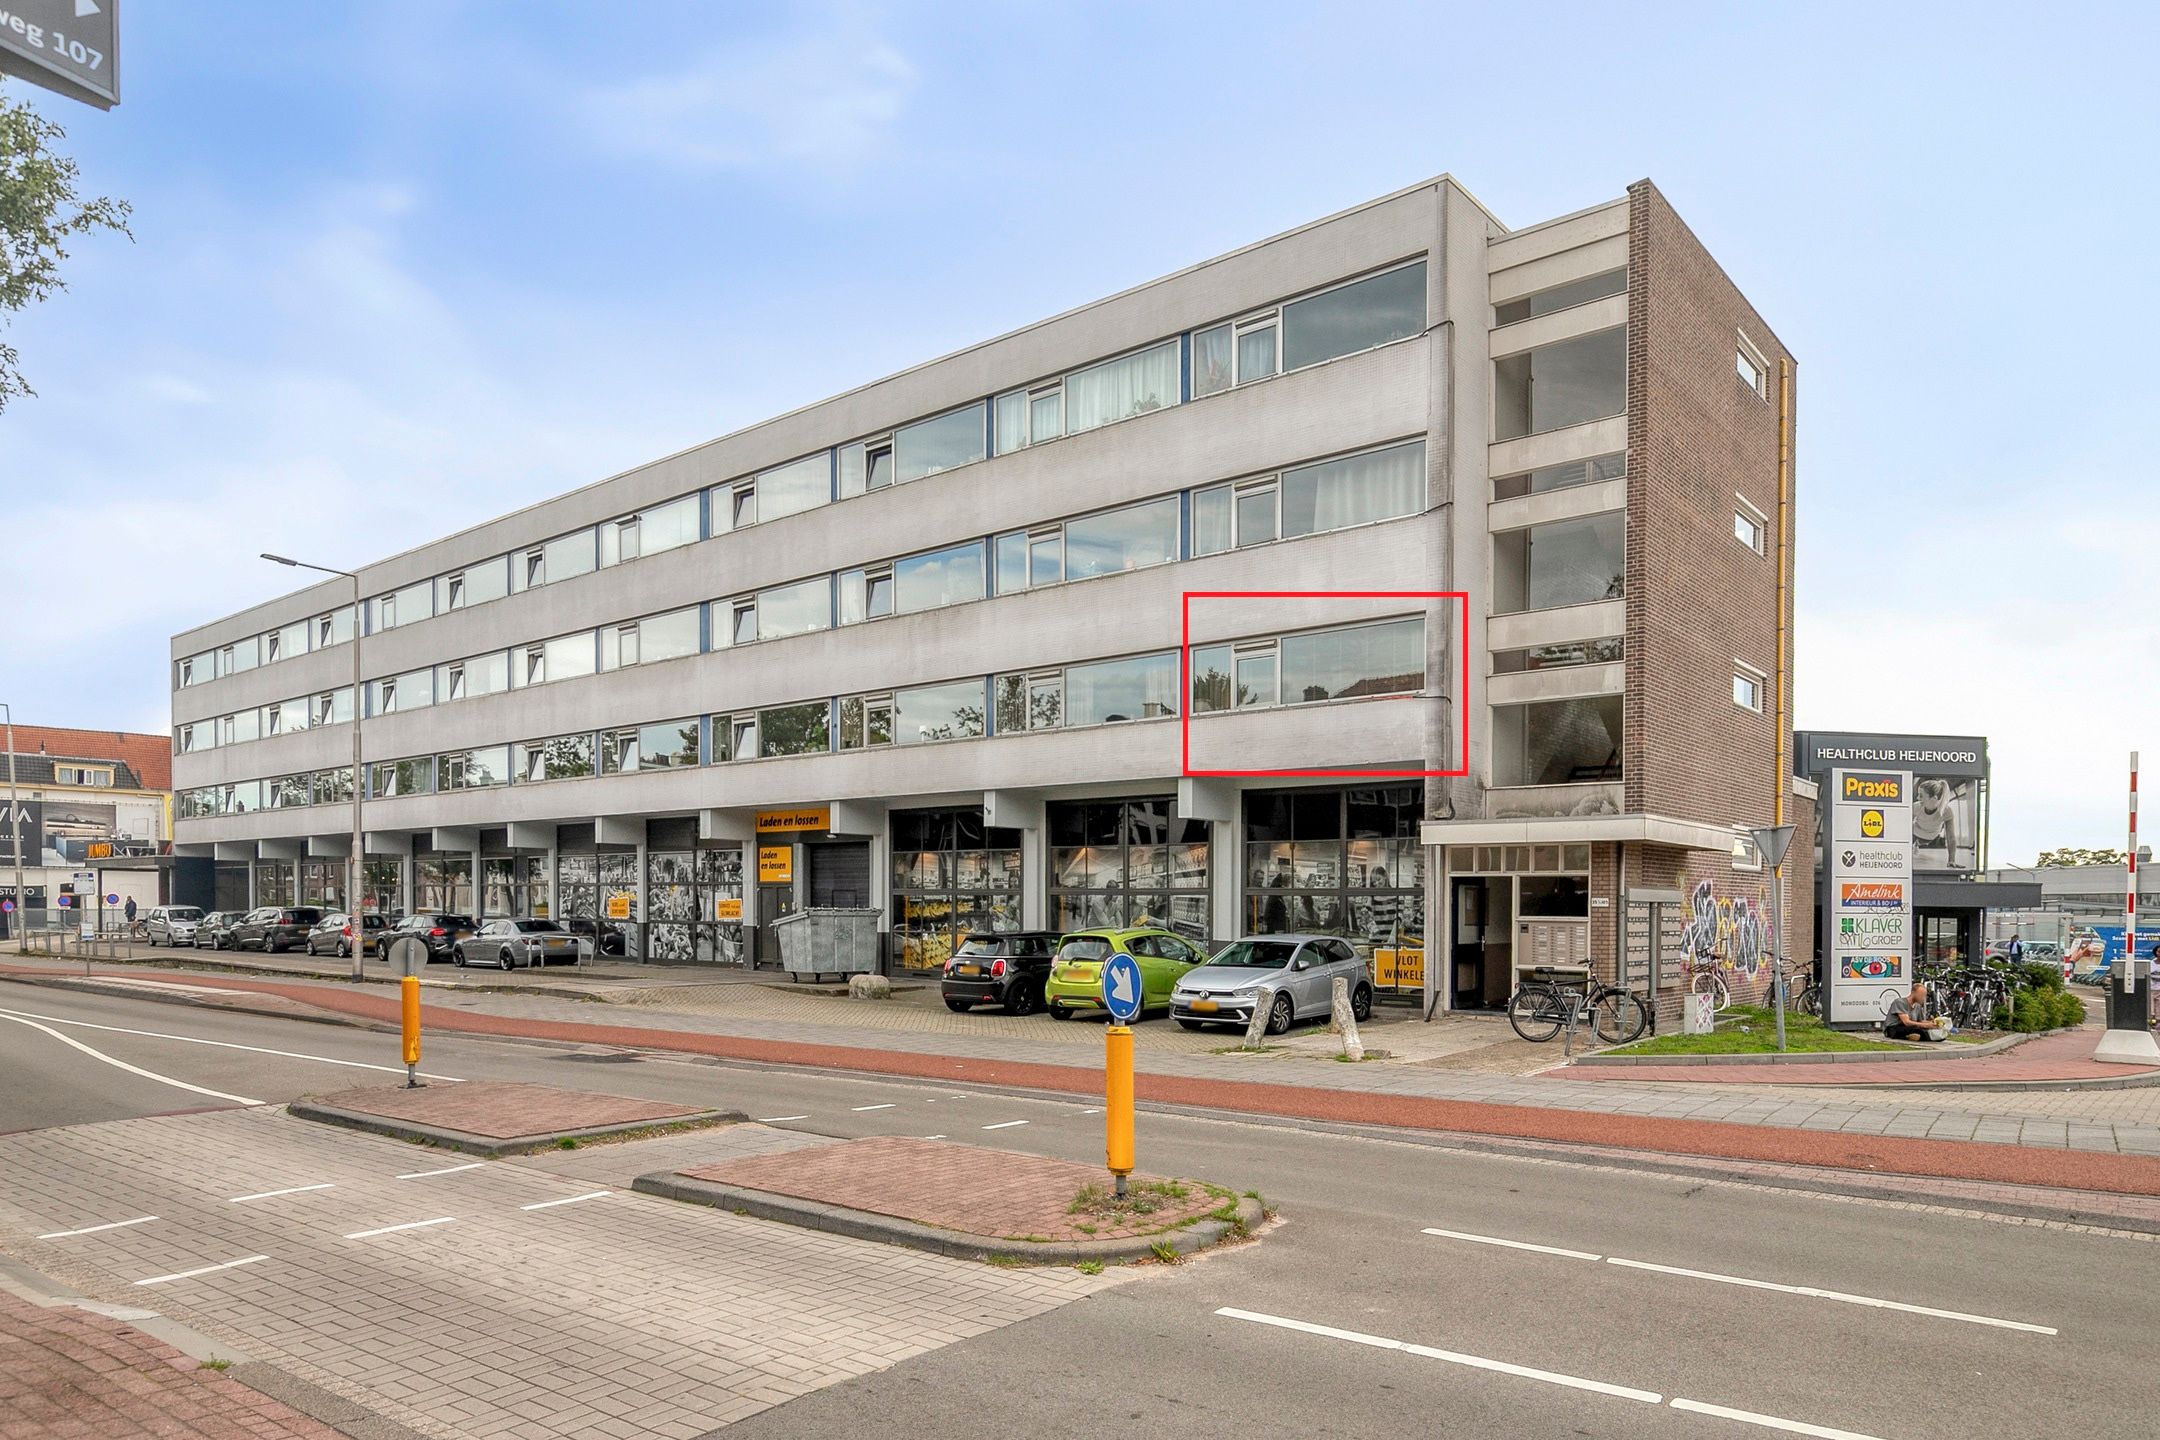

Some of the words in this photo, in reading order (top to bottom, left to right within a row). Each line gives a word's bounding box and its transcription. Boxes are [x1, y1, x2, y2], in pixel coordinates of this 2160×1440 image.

[52, 32, 103, 70] 107
[1817, 748, 1896, 760] HEALTHCLUB
[1899, 751, 1976, 762] HEIJENOORD
[1845, 777, 1899, 798] Praxis
[760, 816, 782, 827] Laden
[783, 817, 793, 826] en
[795, 814, 819, 826] lossen
[88, 844, 112, 858] JUMBO
[761, 850, 778, 859] Laden
[1859, 850, 1903, 860] healthclub
[1845, 882, 1900, 903] Amelink
[1856, 918, 1902, 933] KLAVER
[1871, 936, 1902, 945] GROEP
